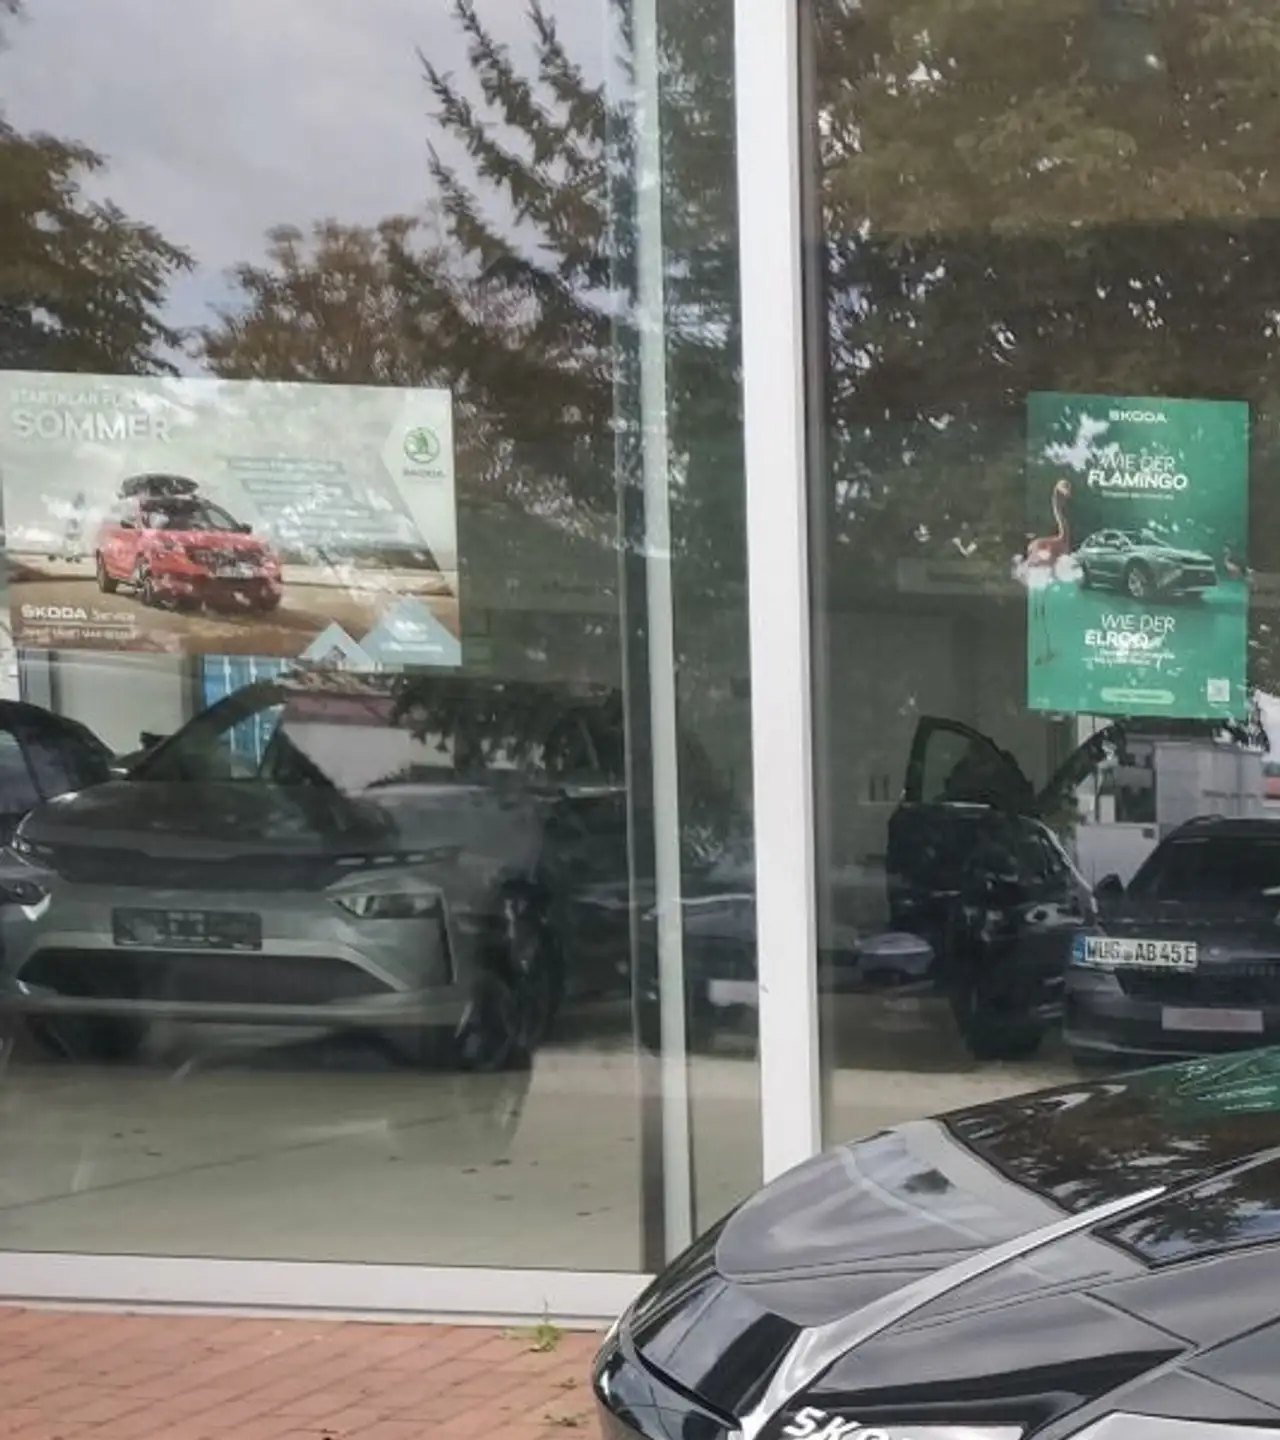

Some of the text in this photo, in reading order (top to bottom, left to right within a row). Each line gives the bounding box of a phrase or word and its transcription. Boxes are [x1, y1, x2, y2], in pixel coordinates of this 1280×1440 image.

[12, 408, 173, 443] SOMMER
[1087, 469, 1189, 490] FLAMINGO
[1101, 612, 1176, 632] WIE DER
